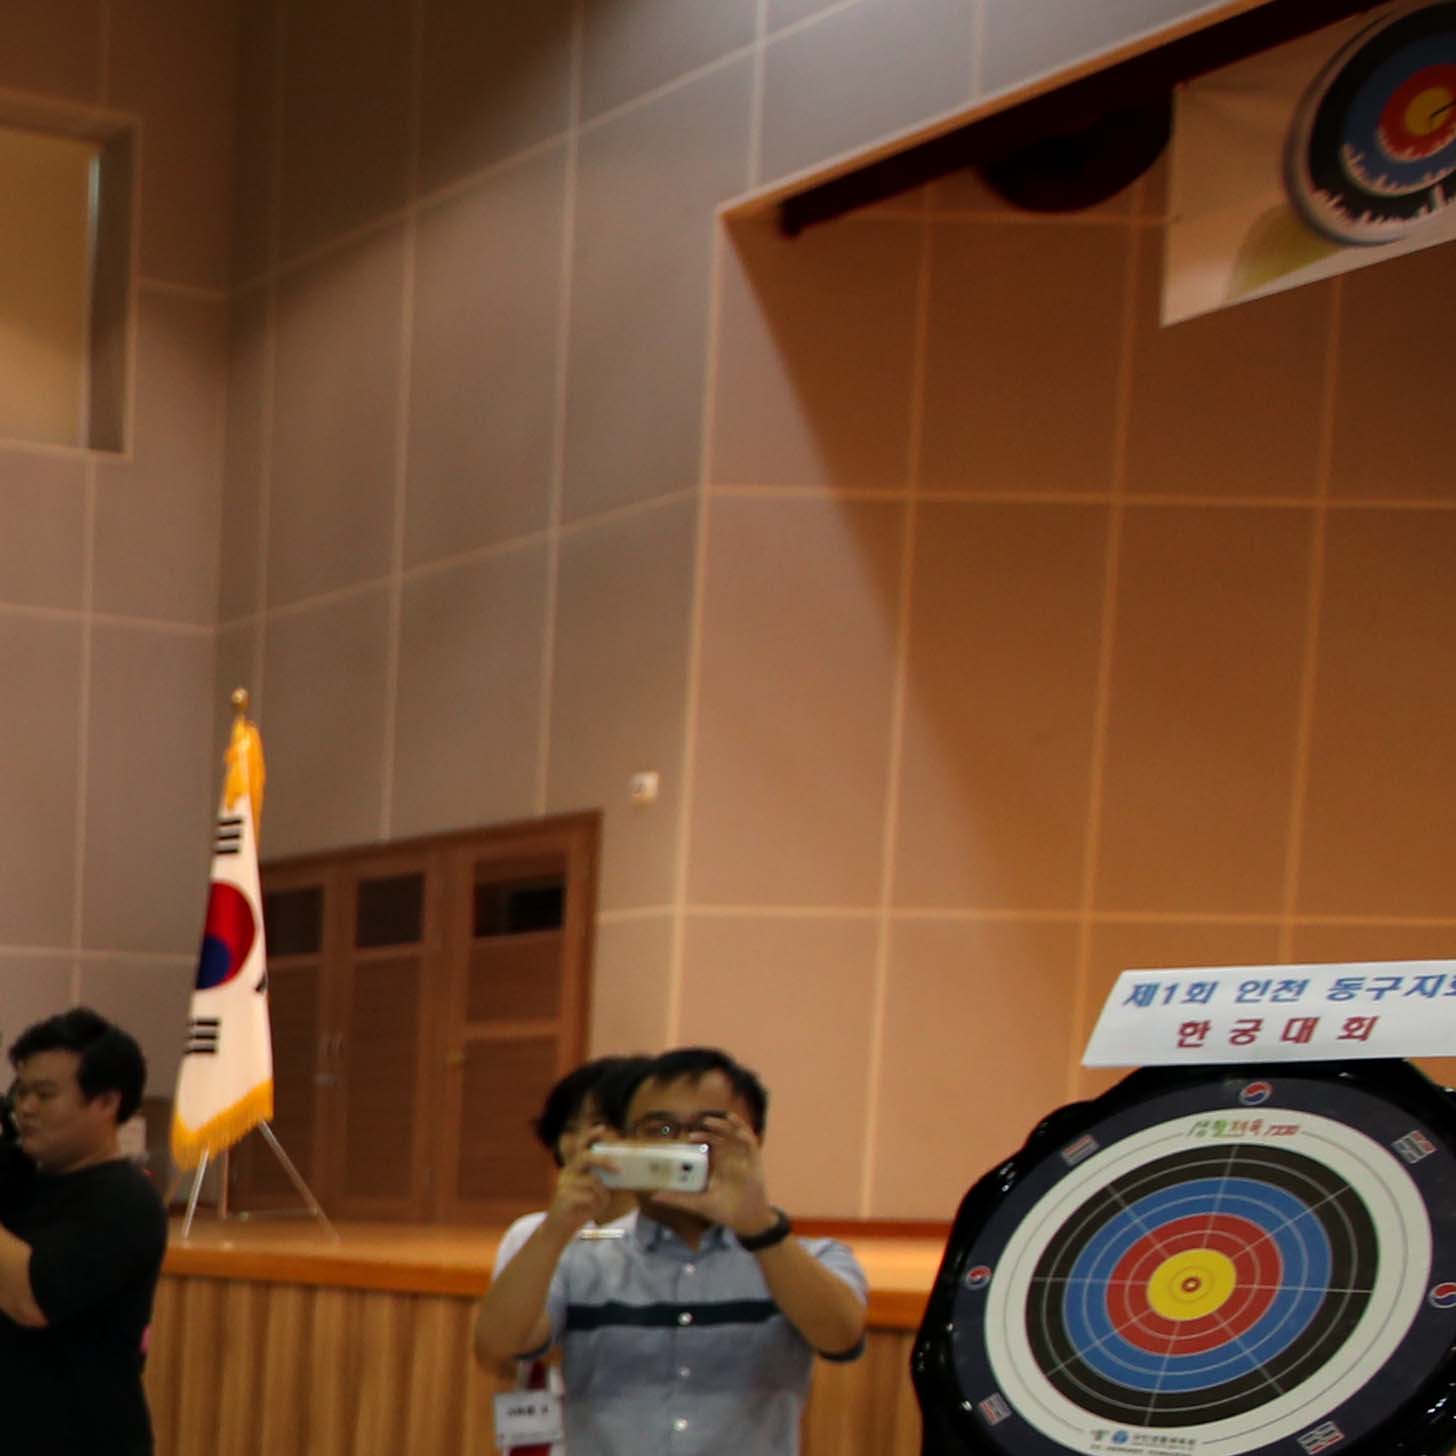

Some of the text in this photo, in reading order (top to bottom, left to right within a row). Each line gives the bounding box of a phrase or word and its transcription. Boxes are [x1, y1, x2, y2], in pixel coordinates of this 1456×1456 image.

[1123, 980, 1219, 1007] 제1회
[1234, 978, 1310, 1004] 인천
[1176, 1015, 1380, 1049] 한궁대회
